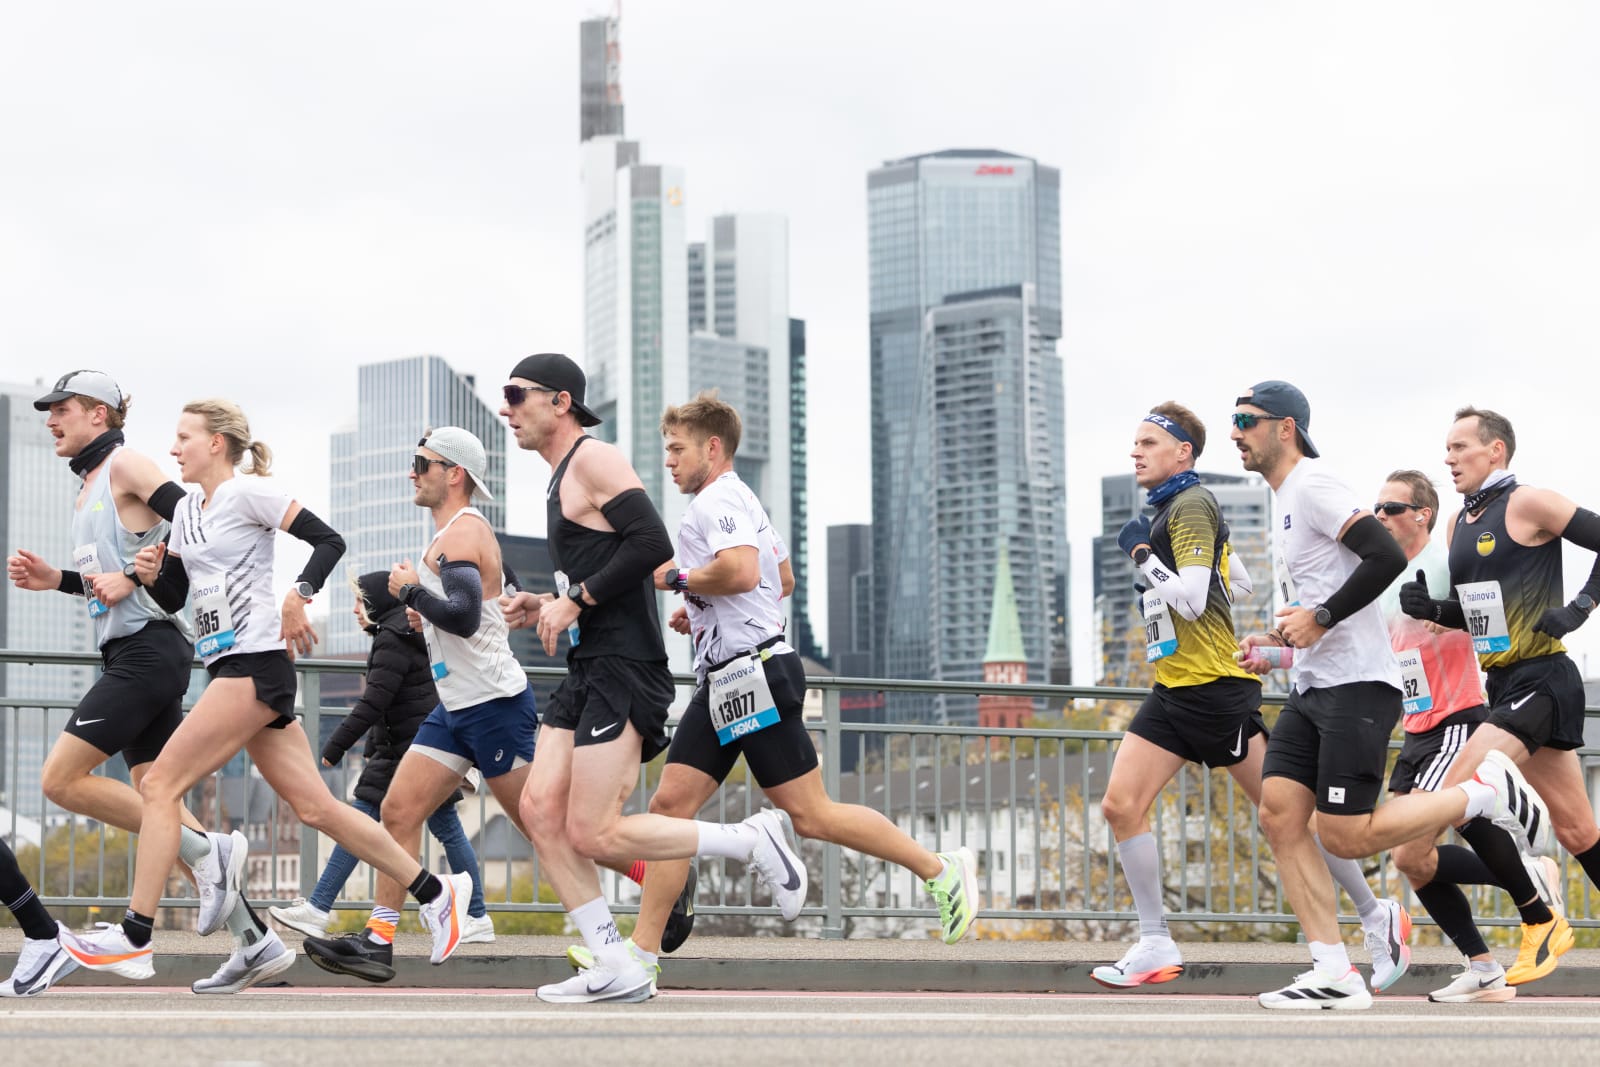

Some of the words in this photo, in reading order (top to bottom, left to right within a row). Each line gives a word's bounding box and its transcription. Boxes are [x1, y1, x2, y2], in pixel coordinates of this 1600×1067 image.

[1466, 591, 1496, 602] mainova
[1469, 615, 1490, 637] 2667
[714, 665, 756, 688] mainova
[718, 690, 755, 725] 13077
[730, 717, 761, 739] HOKA
